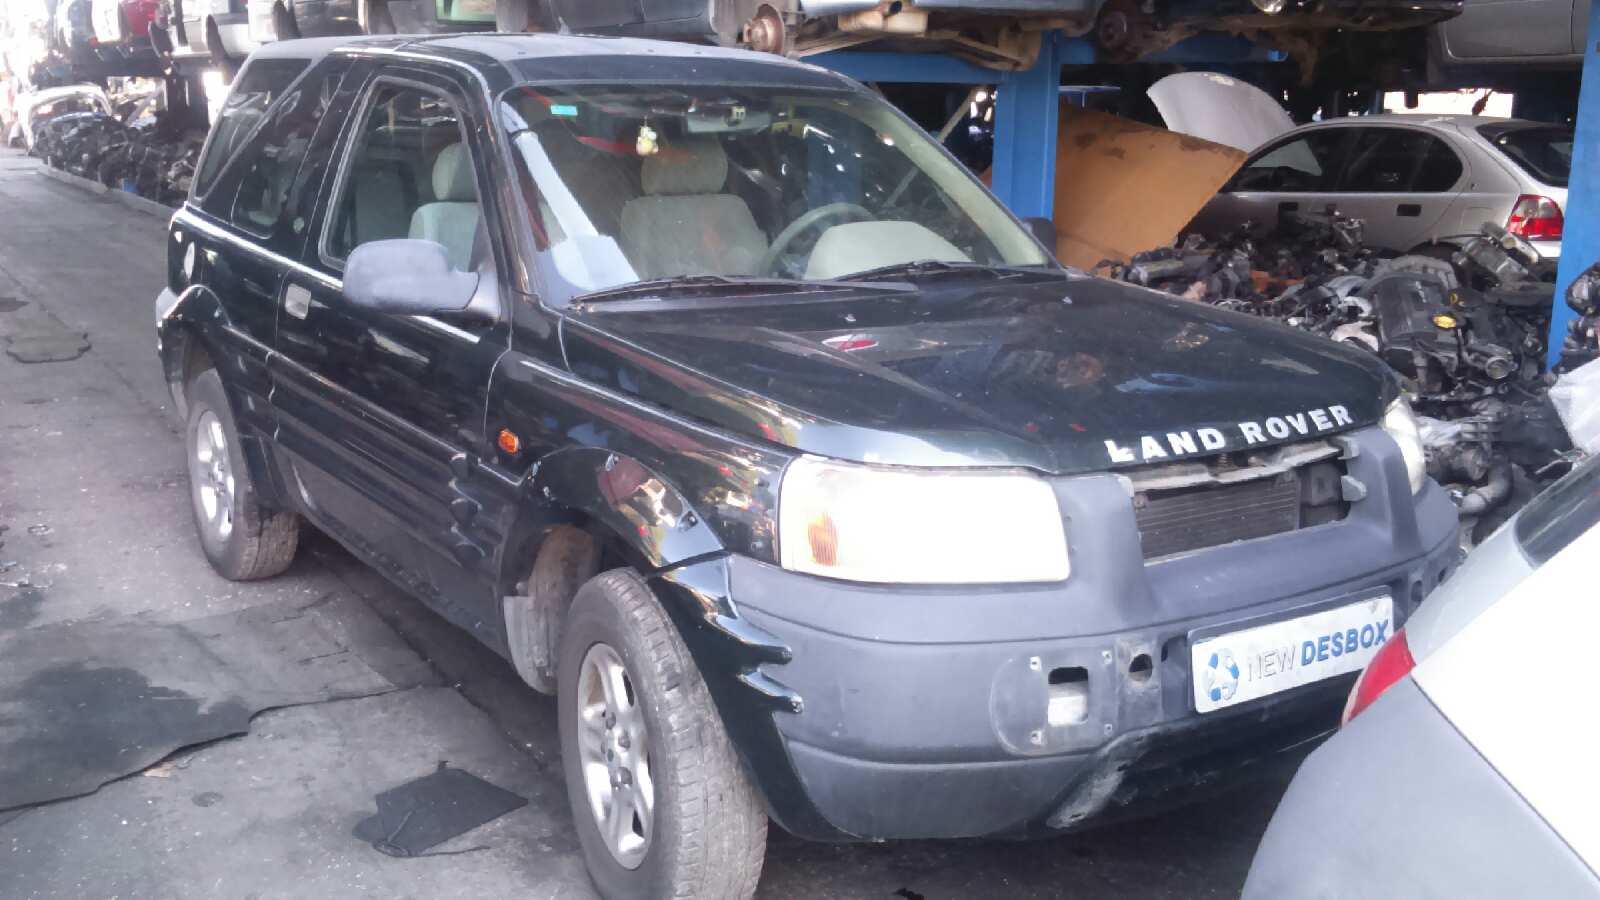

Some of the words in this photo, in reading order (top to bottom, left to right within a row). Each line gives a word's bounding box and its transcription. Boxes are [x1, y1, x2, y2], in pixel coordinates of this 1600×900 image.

[1104, 428, 1226, 463] LAND
[1238, 404, 1353, 444] ROVER
[1247, 644, 1297, 682] NEW
[1301, 618, 1389, 667] DESBOX
